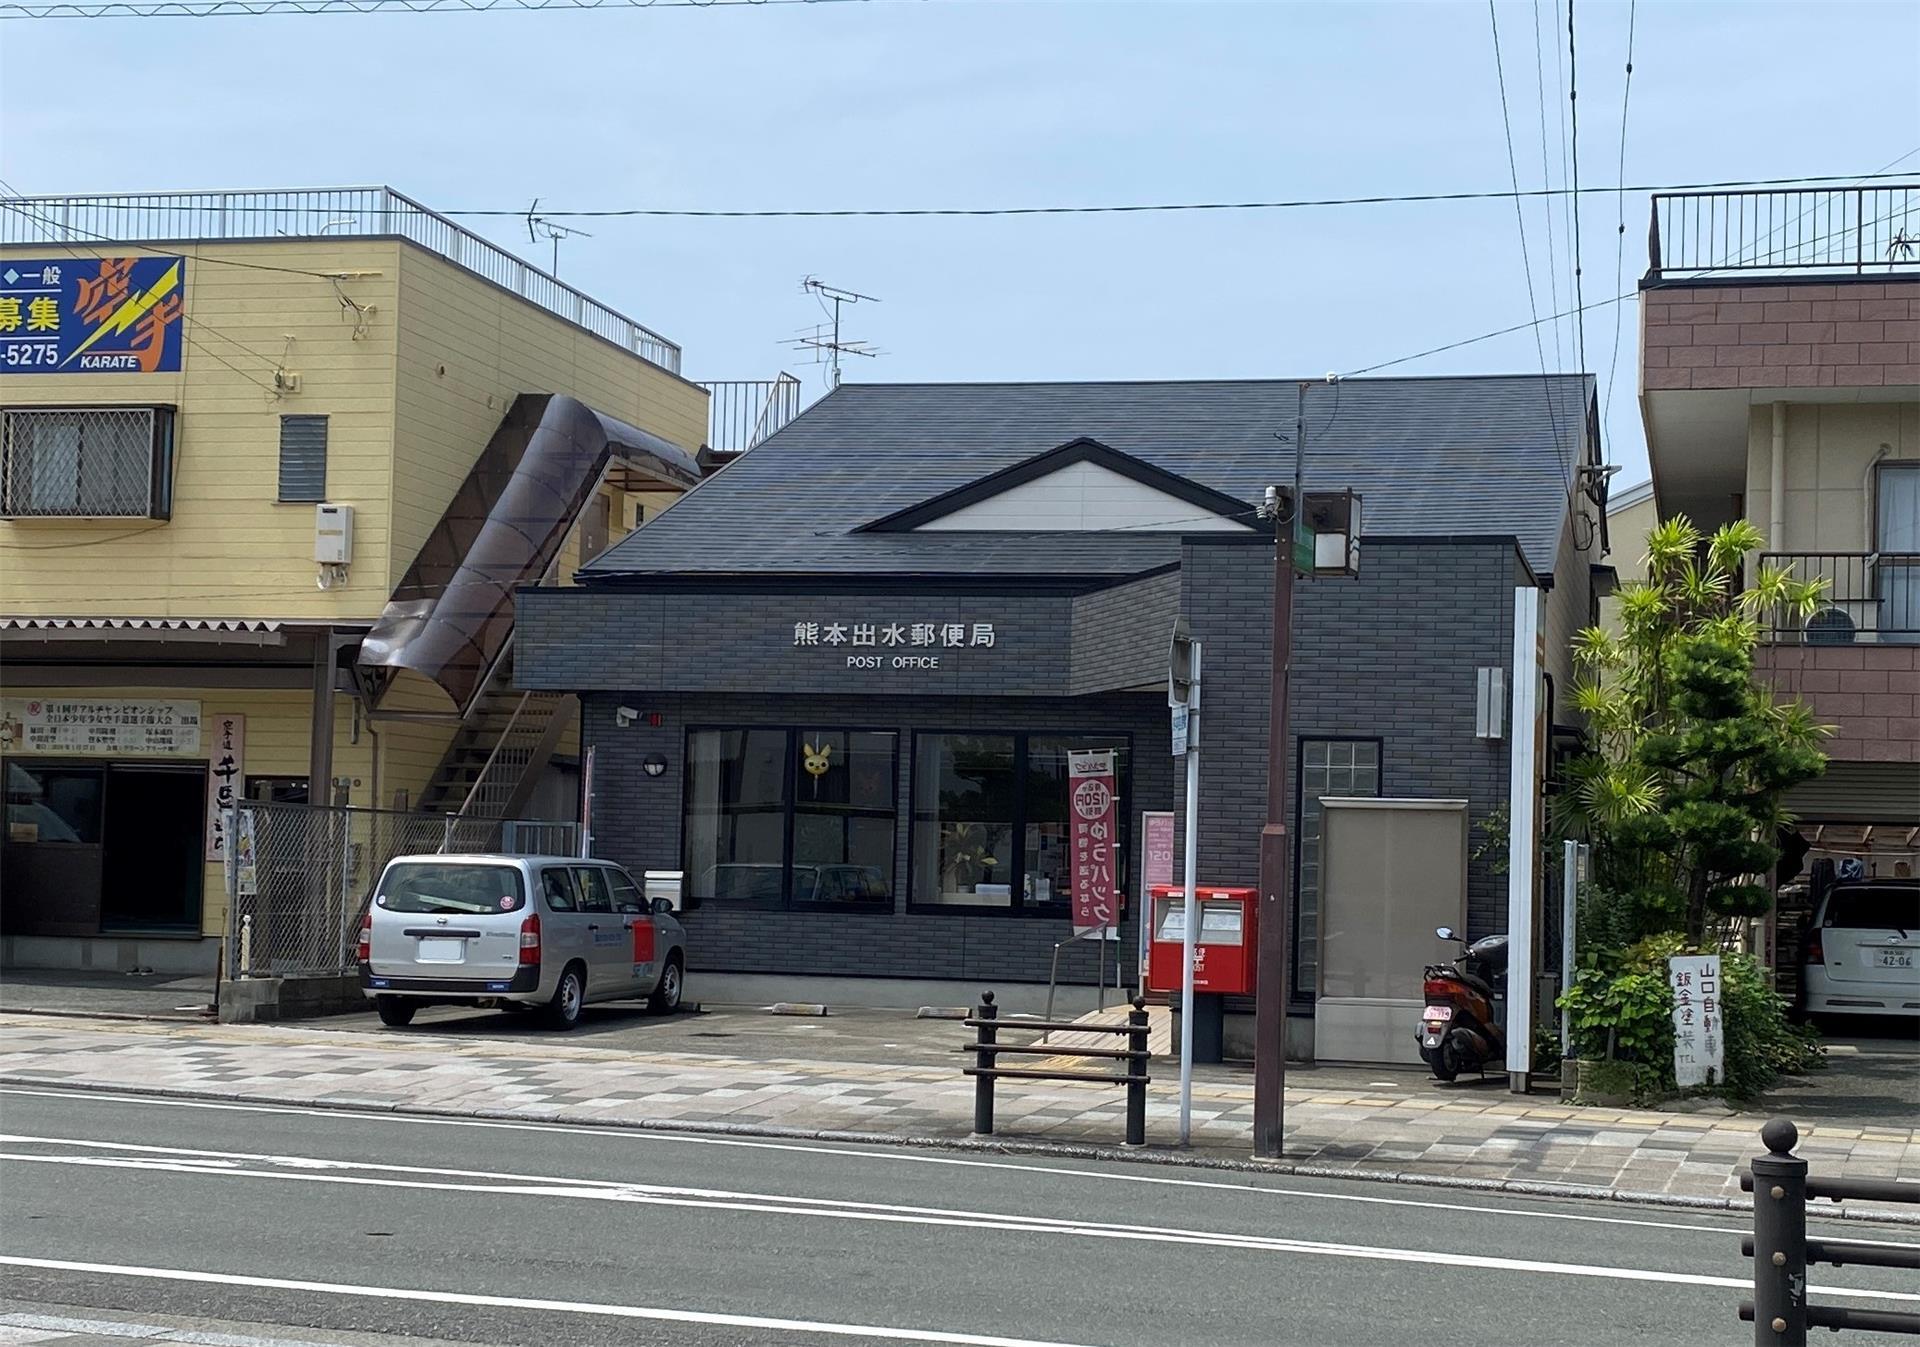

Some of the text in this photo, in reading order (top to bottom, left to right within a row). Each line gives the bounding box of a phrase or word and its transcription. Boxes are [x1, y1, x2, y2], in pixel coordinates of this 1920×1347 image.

[22, 266, 61, 285] 一般
[0, 296, 60, 332] 募集
[80, 355, 137, 369] KARATE
[793, 622, 995, 648] 熊本出水郵便局
[846, 656, 940, 669] POST OFFICE
[1148, 850, 1171, 861] 120
[1679, 1054, 1696, 1064] TEL
